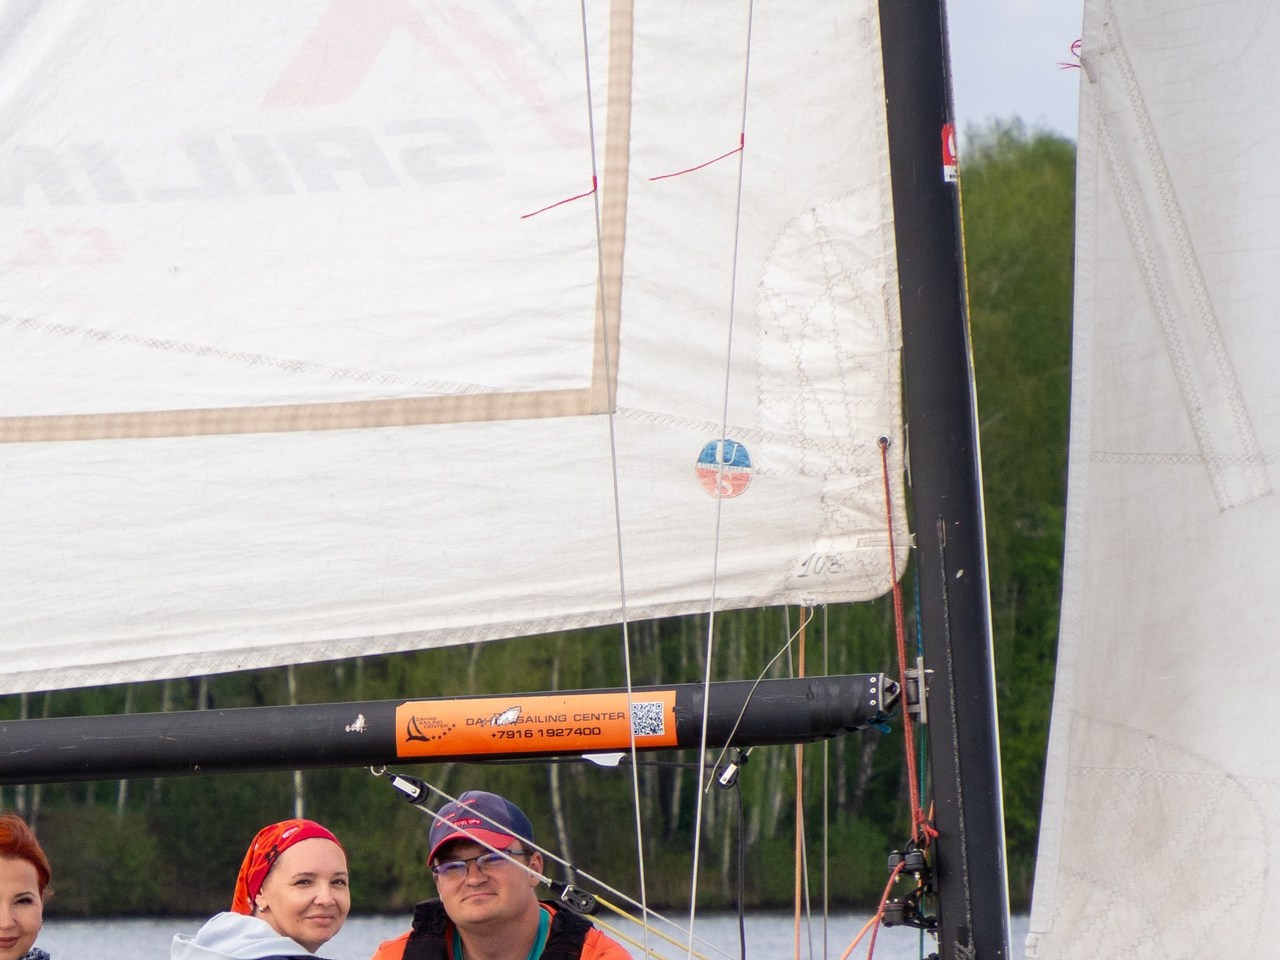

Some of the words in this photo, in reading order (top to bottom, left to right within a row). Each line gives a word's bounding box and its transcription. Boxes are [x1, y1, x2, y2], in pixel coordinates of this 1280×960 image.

[516, 714, 567, 724] SAILING
[573, 711, 626, 722] CENTER
[491, 729, 534, 739] +7916
[538, 727, 601, 738] 1927400
